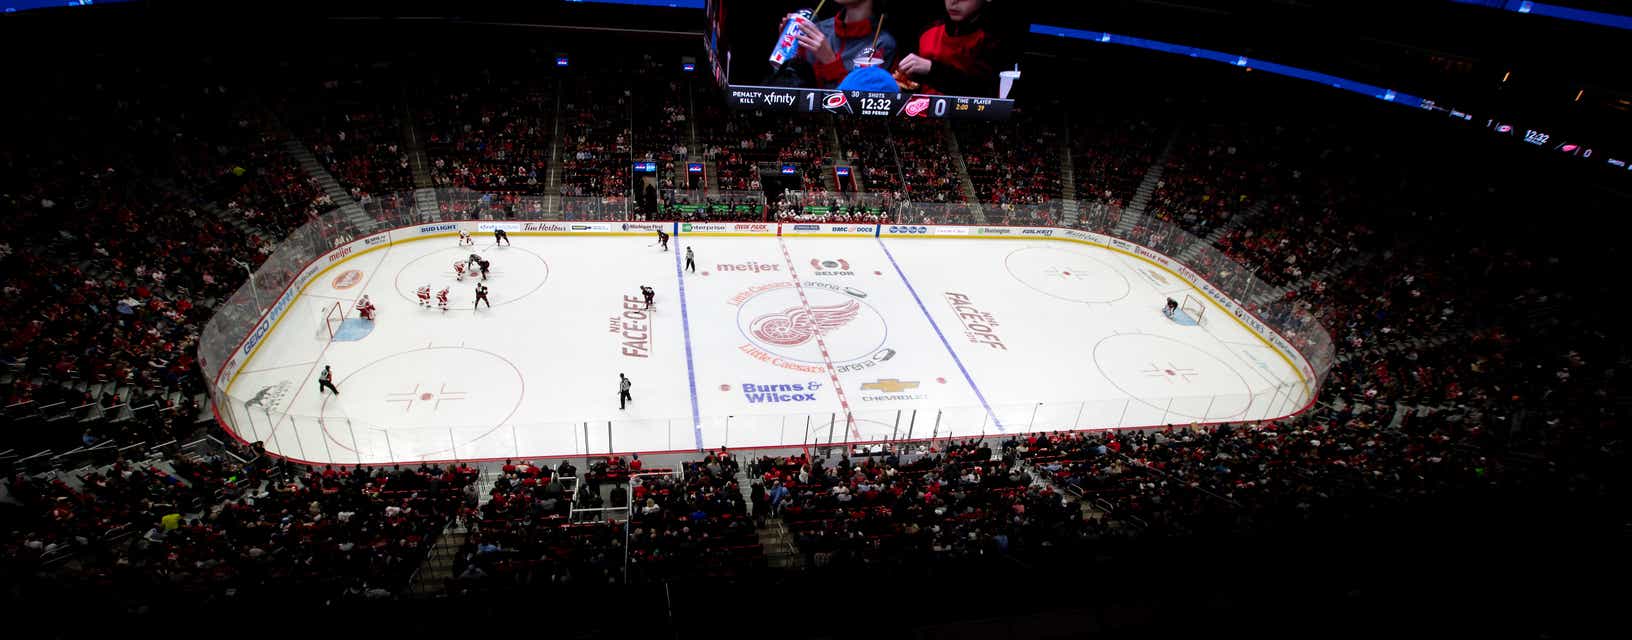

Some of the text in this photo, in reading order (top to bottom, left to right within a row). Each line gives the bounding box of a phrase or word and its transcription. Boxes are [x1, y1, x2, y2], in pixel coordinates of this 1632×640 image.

[764, 92, 796, 106] xfinity
[851, 90, 860, 98] 30
[806, 92, 815, 111] 1
[860, 98, 891, 110] 12:32
[934, 98, 946, 116] 0
[1525, 129, 1550, 144] 12:32
[524, 222, 538, 231] Tim
[329, 246, 353, 262] meijer
[717, 262, 780, 273] meijer
[622, 295, 649, 358] FACE-OFF
[945, 291, 1008, 350] FACE-OFF
[244, 319, 269, 355] GEICO
[742, 381, 822, 393] Burns &
[745, 392, 817, 404] Wilcox
